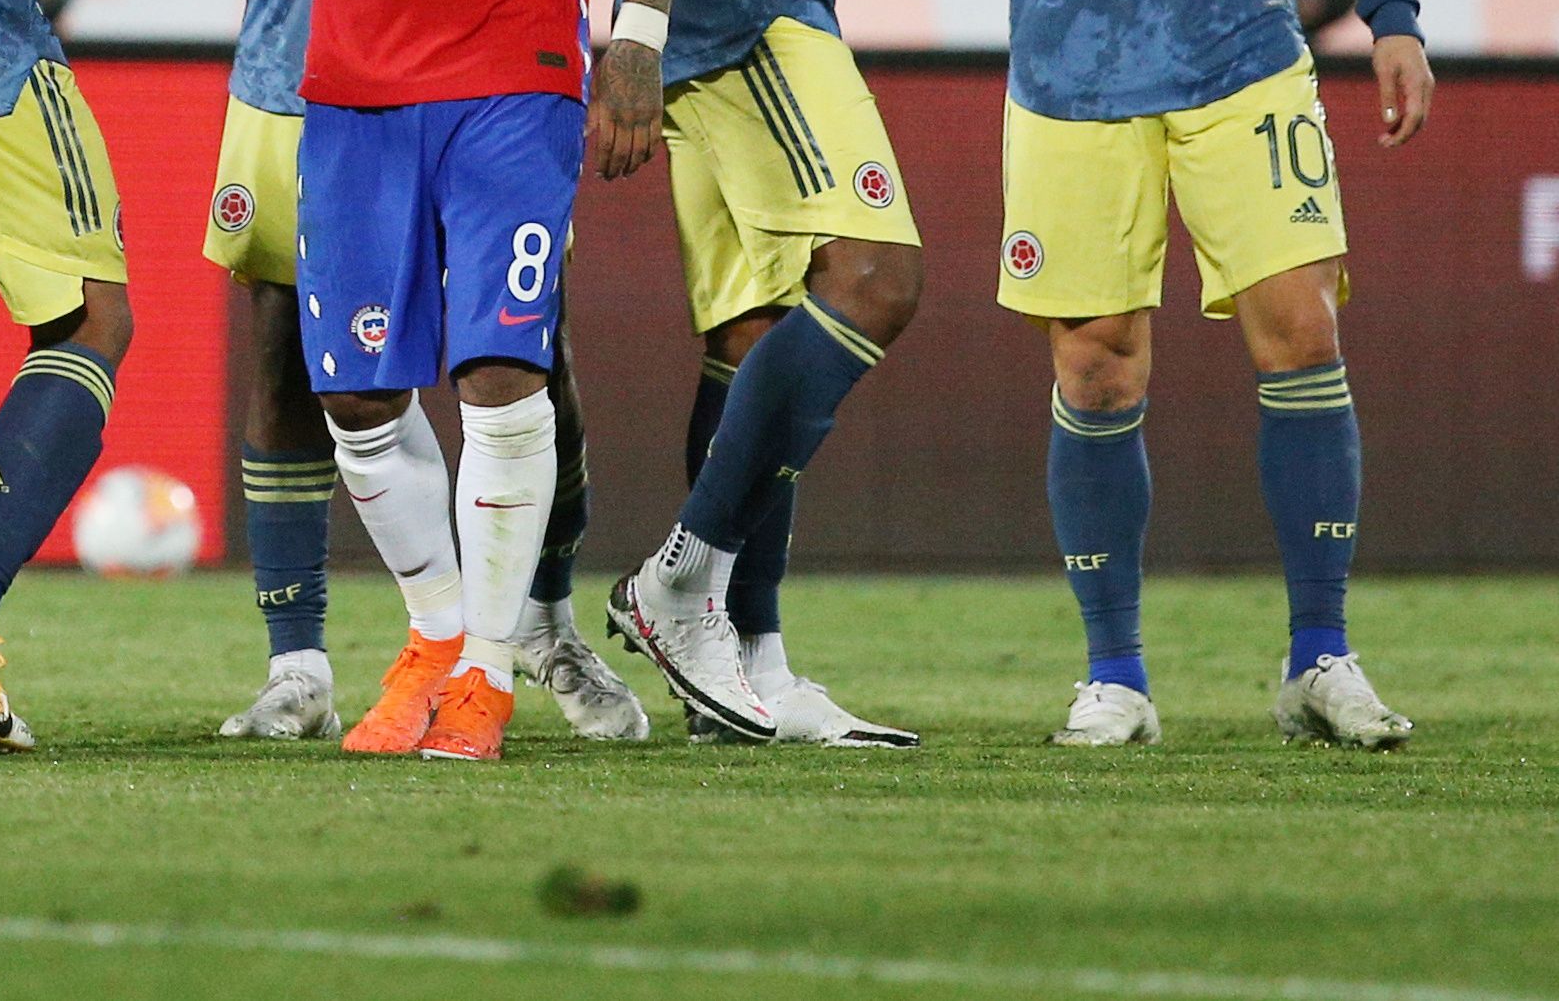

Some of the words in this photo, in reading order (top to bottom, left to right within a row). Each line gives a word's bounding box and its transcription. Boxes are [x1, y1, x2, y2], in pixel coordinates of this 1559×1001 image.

[1254, 113, 1328, 189] 10
[1289, 214, 1328, 224] adidas
[507, 222, 551, 302] 8
[1064, 553, 1109, 570] FCF
[259, 583, 301, 606] FCF
